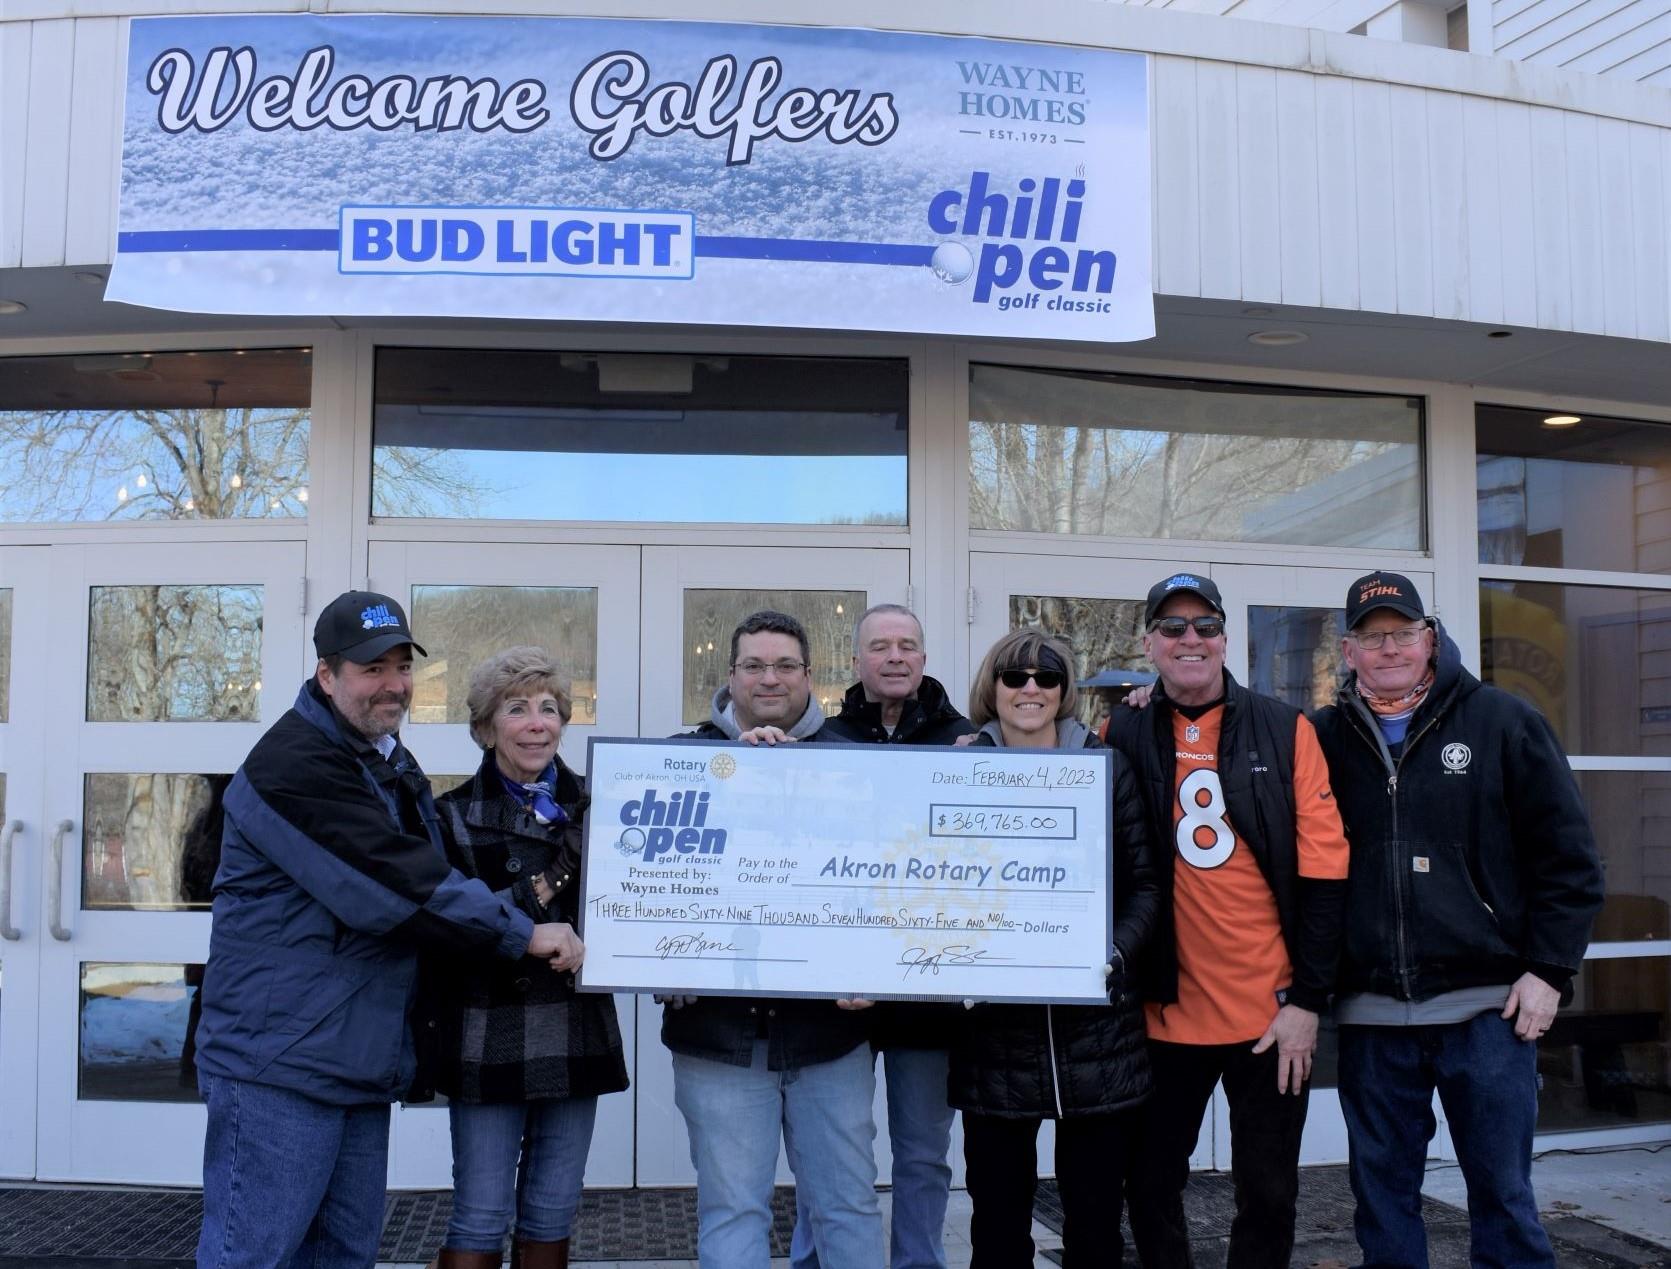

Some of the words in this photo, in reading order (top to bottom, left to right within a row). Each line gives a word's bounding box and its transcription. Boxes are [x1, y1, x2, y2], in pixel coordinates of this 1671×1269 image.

[956, 61, 1085, 95] WAYNE
[147, 45, 550, 133] Welcome
[570, 51, 898, 166] Golfers
[958, 91, 1085, 125] HOMES
[928, 171, 1085, 242] chili
[352, 218, 485, 262] BUD
[496, 219, 682, 267] LIGHT
[998, 293, 1040, 311] golf
[1047, 295, 1111, 314] classic
[1359, 586, 1402, 604] STIHL
[664, 758, 706, 773] Rotary
[1175, 752, 1215, 761] RONCOS
[614, 773, 633, 781] Club
[635, 773, 644, 781] of
[689, 775, 706, 783] USA
[932, 771, 968, 785] Date:
[1056, 766, 1096, 786] 2023
[619, 789, 711, 828] chili
[1175, 768, 1236, 871] 8
[658, 855, 682, 865] golf
[685, 856, 722, 865] classic
[738, 857, 759, 869] Pay
[763, 859, 776, 868] to
[779, 858, 798, 869] the
[629, 867, 689, 879] Presented
[692, 868, 711, 884] by:
[737, 872, 774, 884] Order
[776, 873, 791, 884] of
[819, 855, 896, 880] Akron
[905, 857, 993, 888] Rotary
[1000, 860, 1067, 889] Camp
[621, 882, 666, 897] Wayne
[671, 883, 719, 895] Homes
[1023, 922, 1070, 934] Dollars
